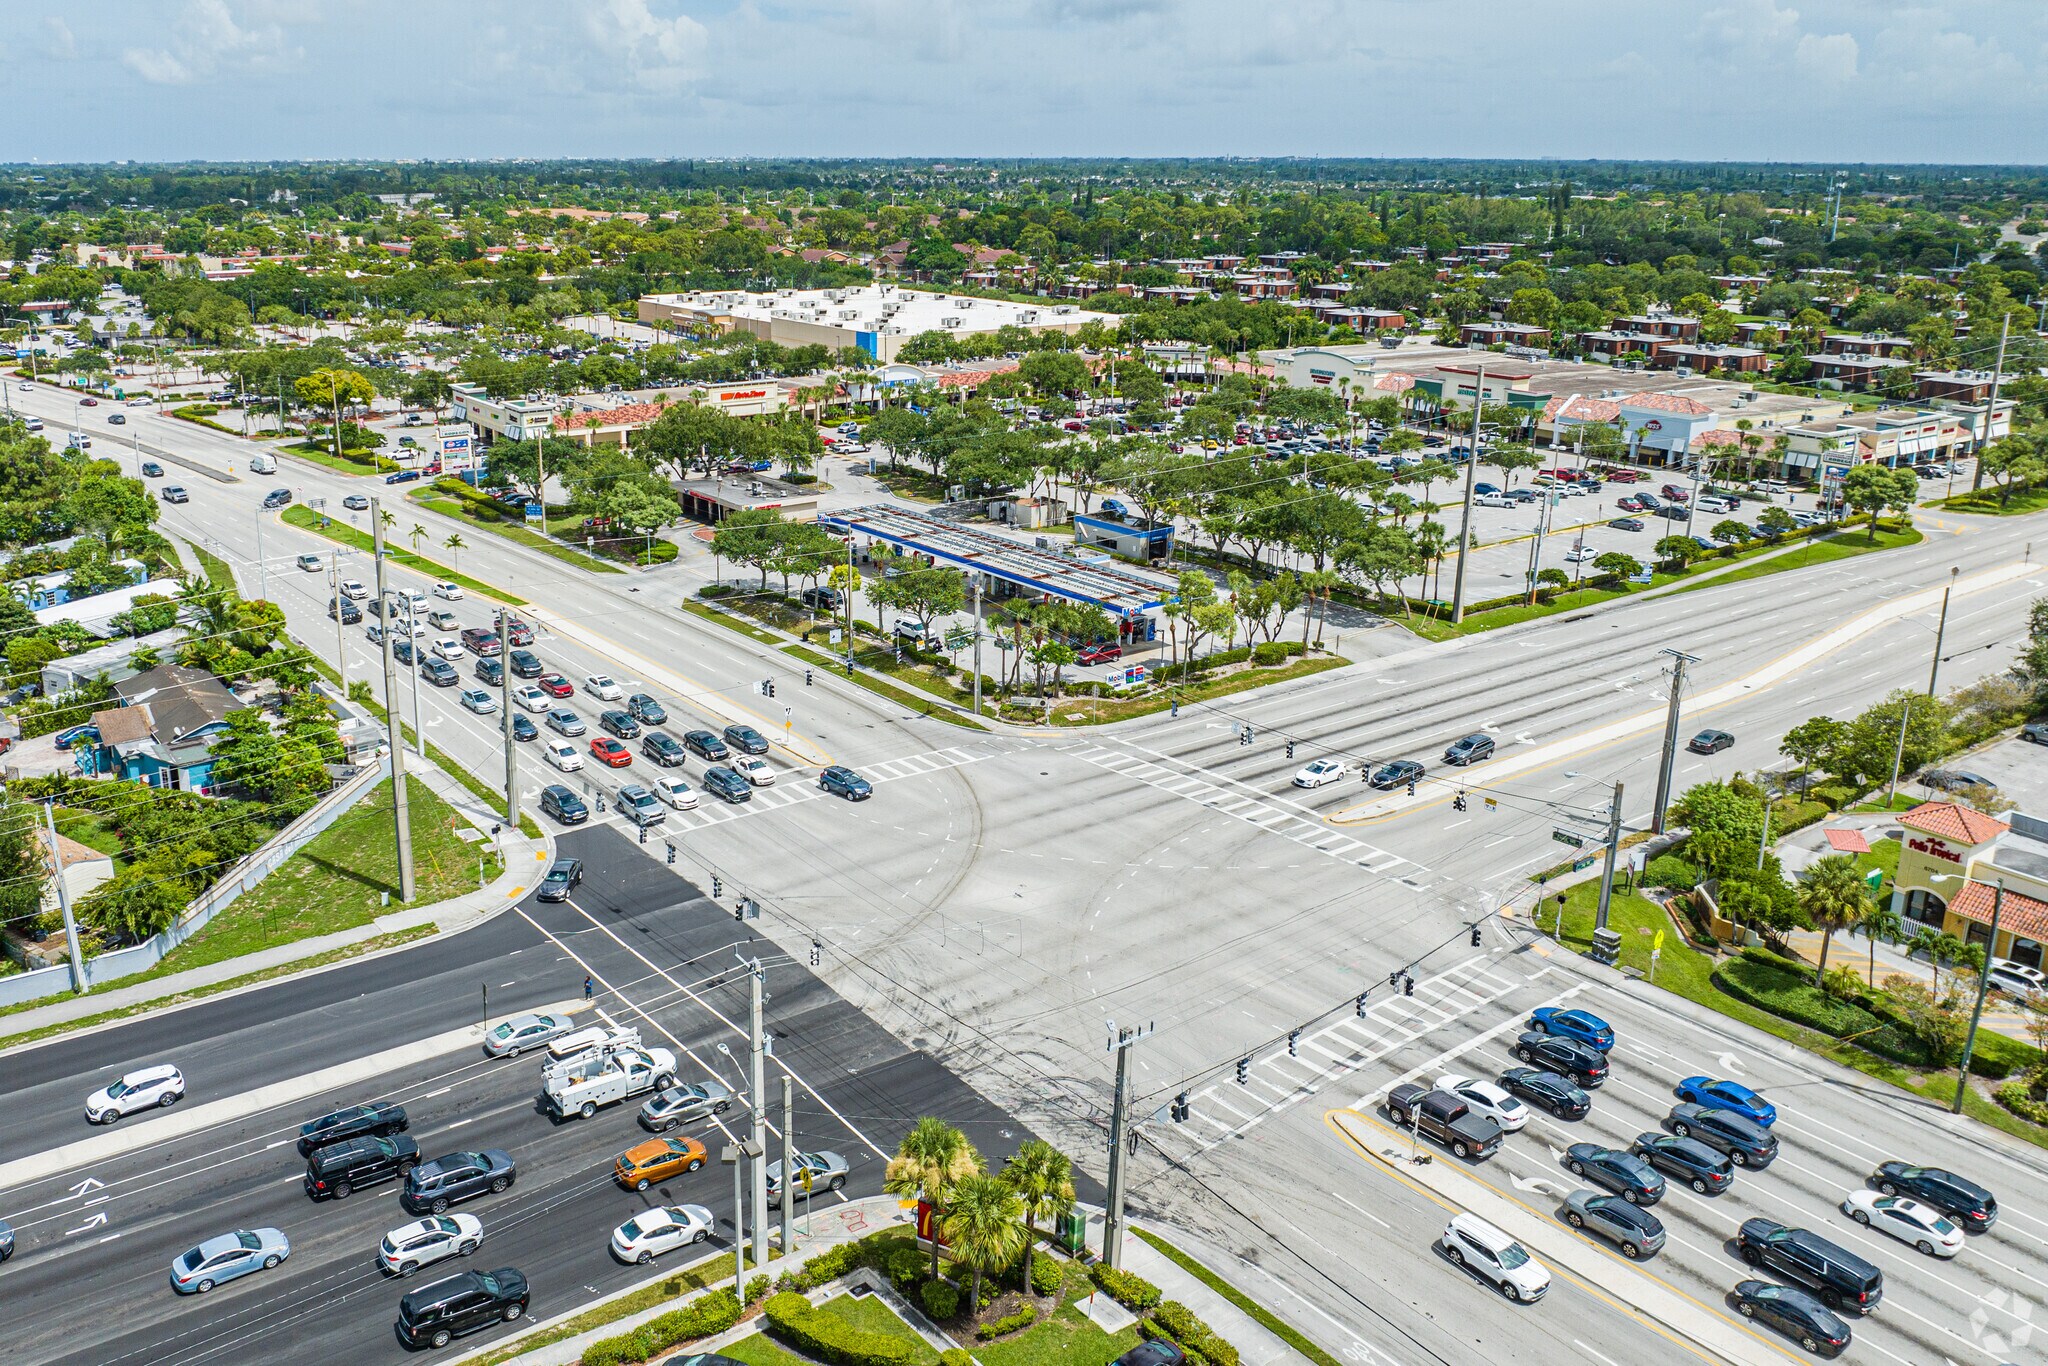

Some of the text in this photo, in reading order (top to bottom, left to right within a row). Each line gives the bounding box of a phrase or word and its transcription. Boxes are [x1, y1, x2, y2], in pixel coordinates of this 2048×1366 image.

[733, 390, 766, 399] AutoZone
[1123, 606, 1142, 617] Mobil
[1108, 673, 1125, 683] Mobil
[1909, 839, 1961, 863] Pollo Tropical
